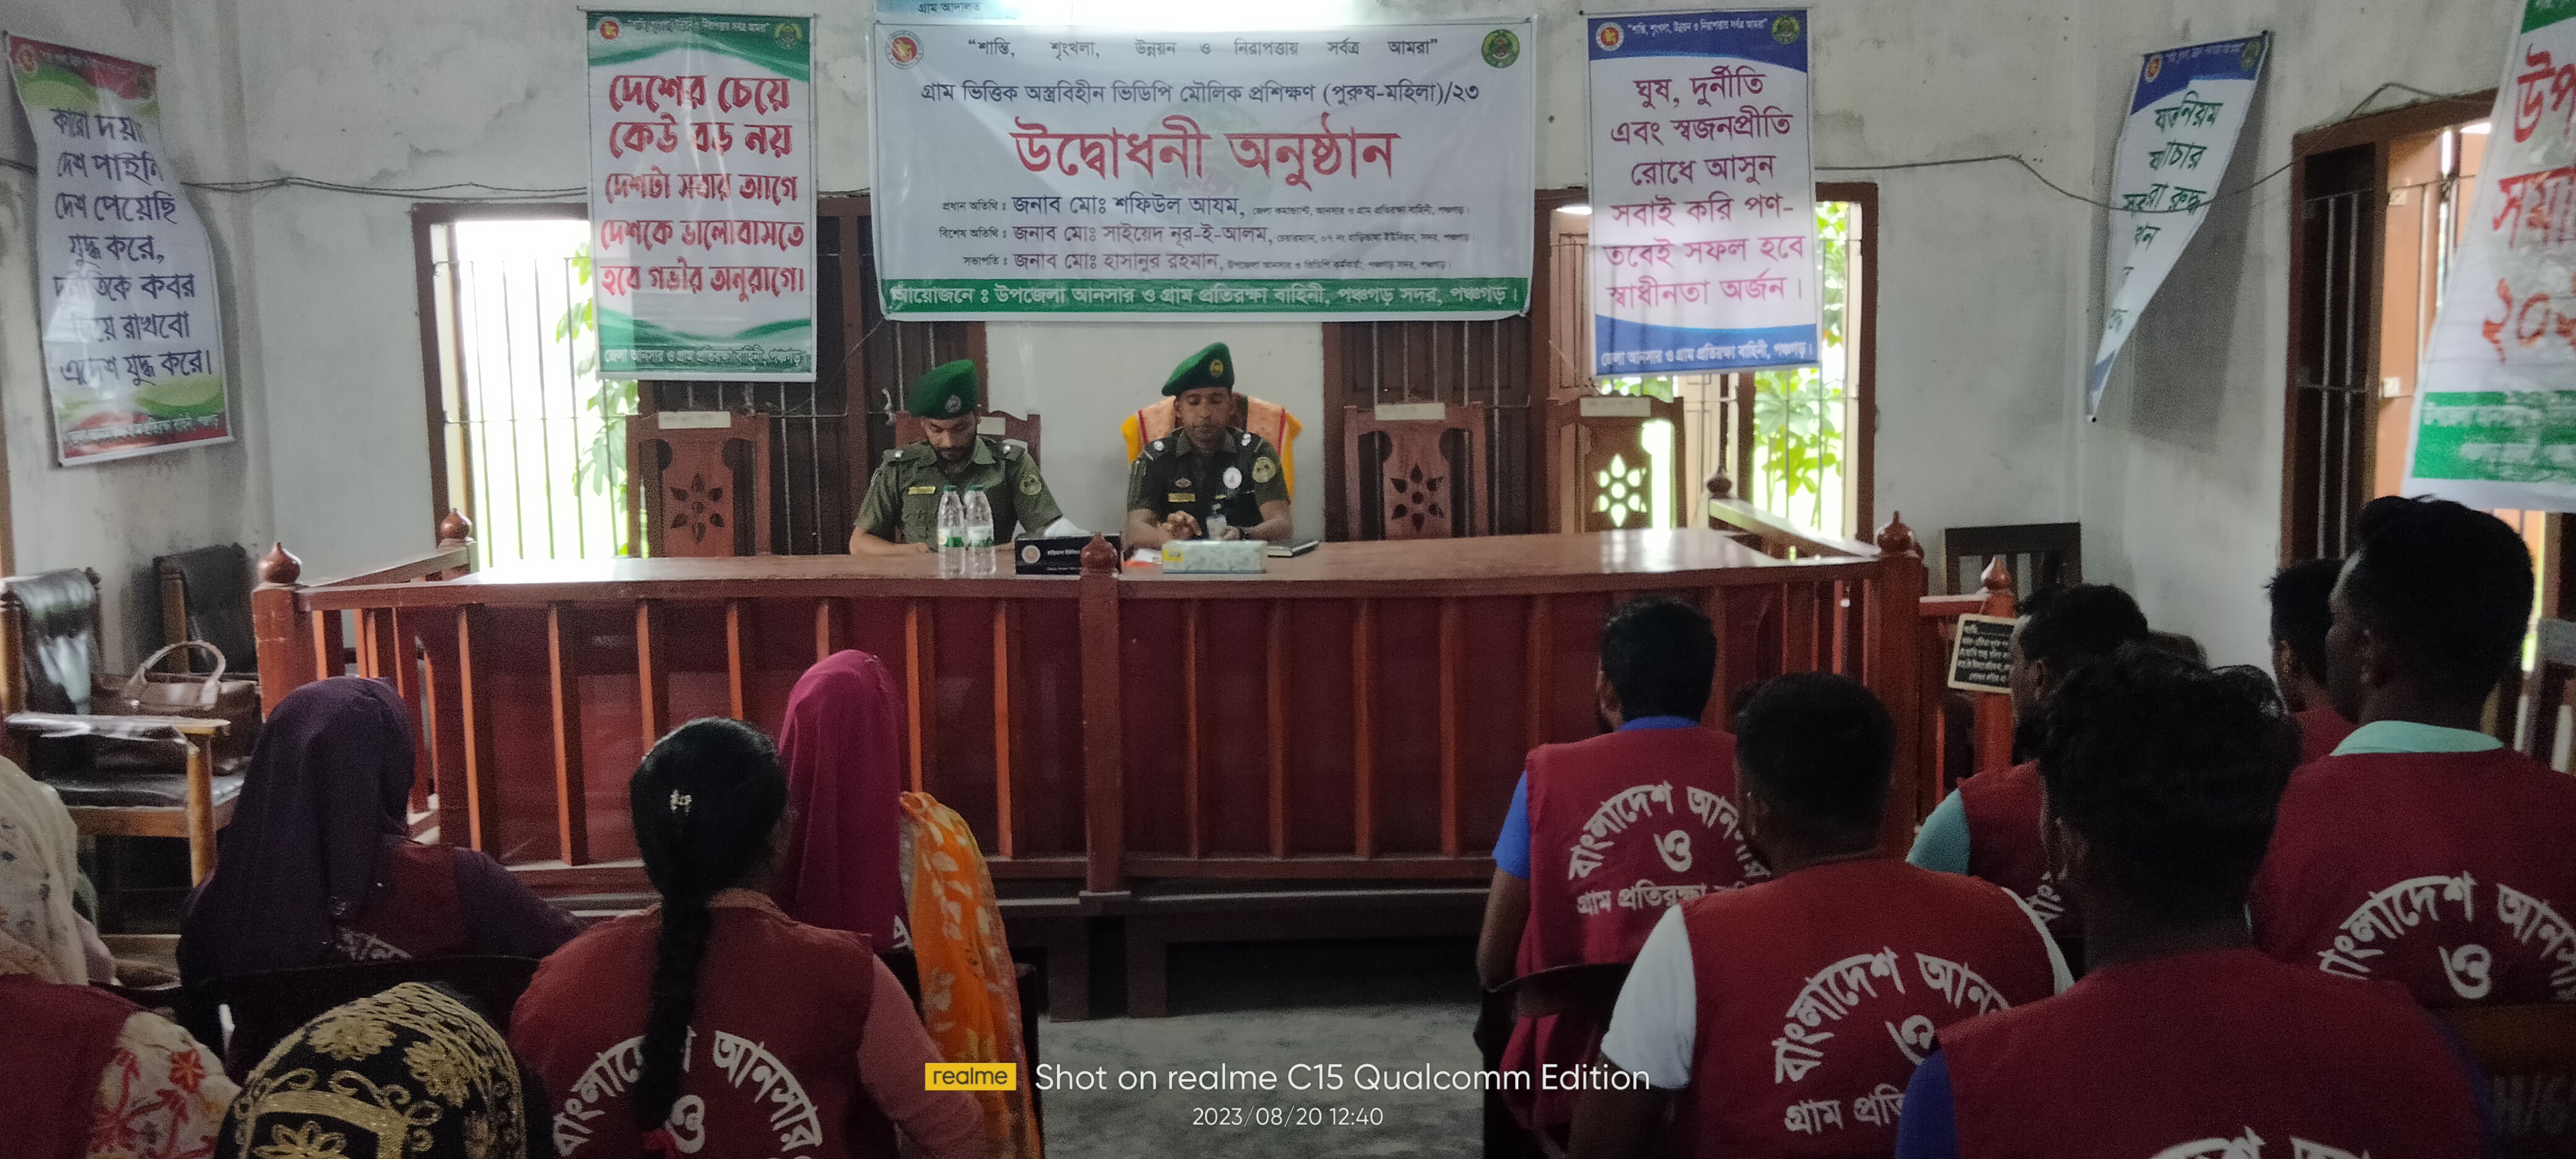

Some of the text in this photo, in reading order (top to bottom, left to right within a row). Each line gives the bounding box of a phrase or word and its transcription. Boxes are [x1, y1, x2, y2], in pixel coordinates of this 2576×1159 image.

[918, 2, 982, 14] গ্রাম আদালত
[1051, 40, 1100, 60] শৃংখলা,
[1135, 38, 1176, 58] উন্নয়ন
[1199, 43, 1211, 54] ও
[1234, 37, 1299, 56] নিরাপত্তায়
[1328, 37, 1360, 55] সর্বত্র
[609, 75, 791, 116] দেশের চেয়ে
[921, 82, 956, 102] গ্রাম
[962, 80, 1019, 103] ভিত্তিক
[1025, 79, 1106, 105] অস্ত্রবিহীন
[1113, 80, 1173, 103] ভিডিপি
[1180, 80, 1242, 104] মৌলিক
[1249, 79, 1316, 104] প্রশিক্ষণ
[1633, 64, 1766, 109] ঘুষ, দুর্নীতি
[609, 112, 679, 159] কেউ
[744, 124, 793, 158] নয়
[1611, 105, 1793, 147] এবং স্বজনপ্রীতি
[56, 150, 89, 178] দেশ
[1009, 111, 1401, 193] উদ্বোধনী অনুষ্ঠান
[606, 165, 799, 206] দেশটা সবার আগে
[1630, 154, 1777, 186] রোধে আসুন
[54, 190, 178, 224] দেশ পেয়েছি
[942, 202, 967, 211] প্রধান
[969, 199, 999, 211] অতিথি
[1011, 195, 1063, 214] জনাব
[1069, 195, 1106, 215] মোঃ
[1112, 191, 1181, 215] শফিউল
[1189, 196, 1245, 218] আযম,
[1611, 196, 1677, 228] সবাই
[1684, 190, 1734, 223] করি
[104, 234, 165, 264] করে,
[601, 220, 805, 252] দেশকে ভালোবাসতে
[939, 226, 967, 238] বিশেষ
[969, 226, 999, 238] অতিথি
[1012, 225, 1058, 241] জনাব
[1064, 225, 1095, 242] মোঃ
[1103, 224, 1165, 243] সাইয়েদ
[963, 254, 999, 266] সভাপতি
[1012, 252, 1058, 269] জনাব
[1064, 252, 1095, 269] মোঃ
[1103, 252, 1160, 273] হাসানুর
[1603, 236, 1806, 268] তবেই সফল হবে
[139, 274, 194, 300] কবর
[600, 265, 641, 297] হবে
[648, 256, 703, 295] গভীর
[890, 287, 975, 304] আয়োজনে
[993, 282, 1067, 304] উপজেলা
[1072, 287, 1136, 304] আনসার
[1142, 289, 1155, 303] ও
[1160, 287, 1194, 304] গ্রাম
[1199, 282, 1268, 304] প্রতিরক্ষা
[1606, 275, 1709, 309] স্বাধীনতা
[1720, 269, 1787, 302] অর্জন
[120, 311, 189, 341] রাখবো
[123, 354, 156, 386] যুদ্ধ
[1567, 780, 1674, 881] বাংলাদেশ
[1653, 830, 1692, 872] ও
[1577, 890, 1611, 916] গ্রাম
[2438, 944, 2492, 999] ও
[1771, 946, 1906, 1083] বাংলাদেশ
[712, 1030, 823, 1152] আনসার
[664, 1095, 705, 1154] ও
[1784, 1100, 1844, 1135] গ্রাম
